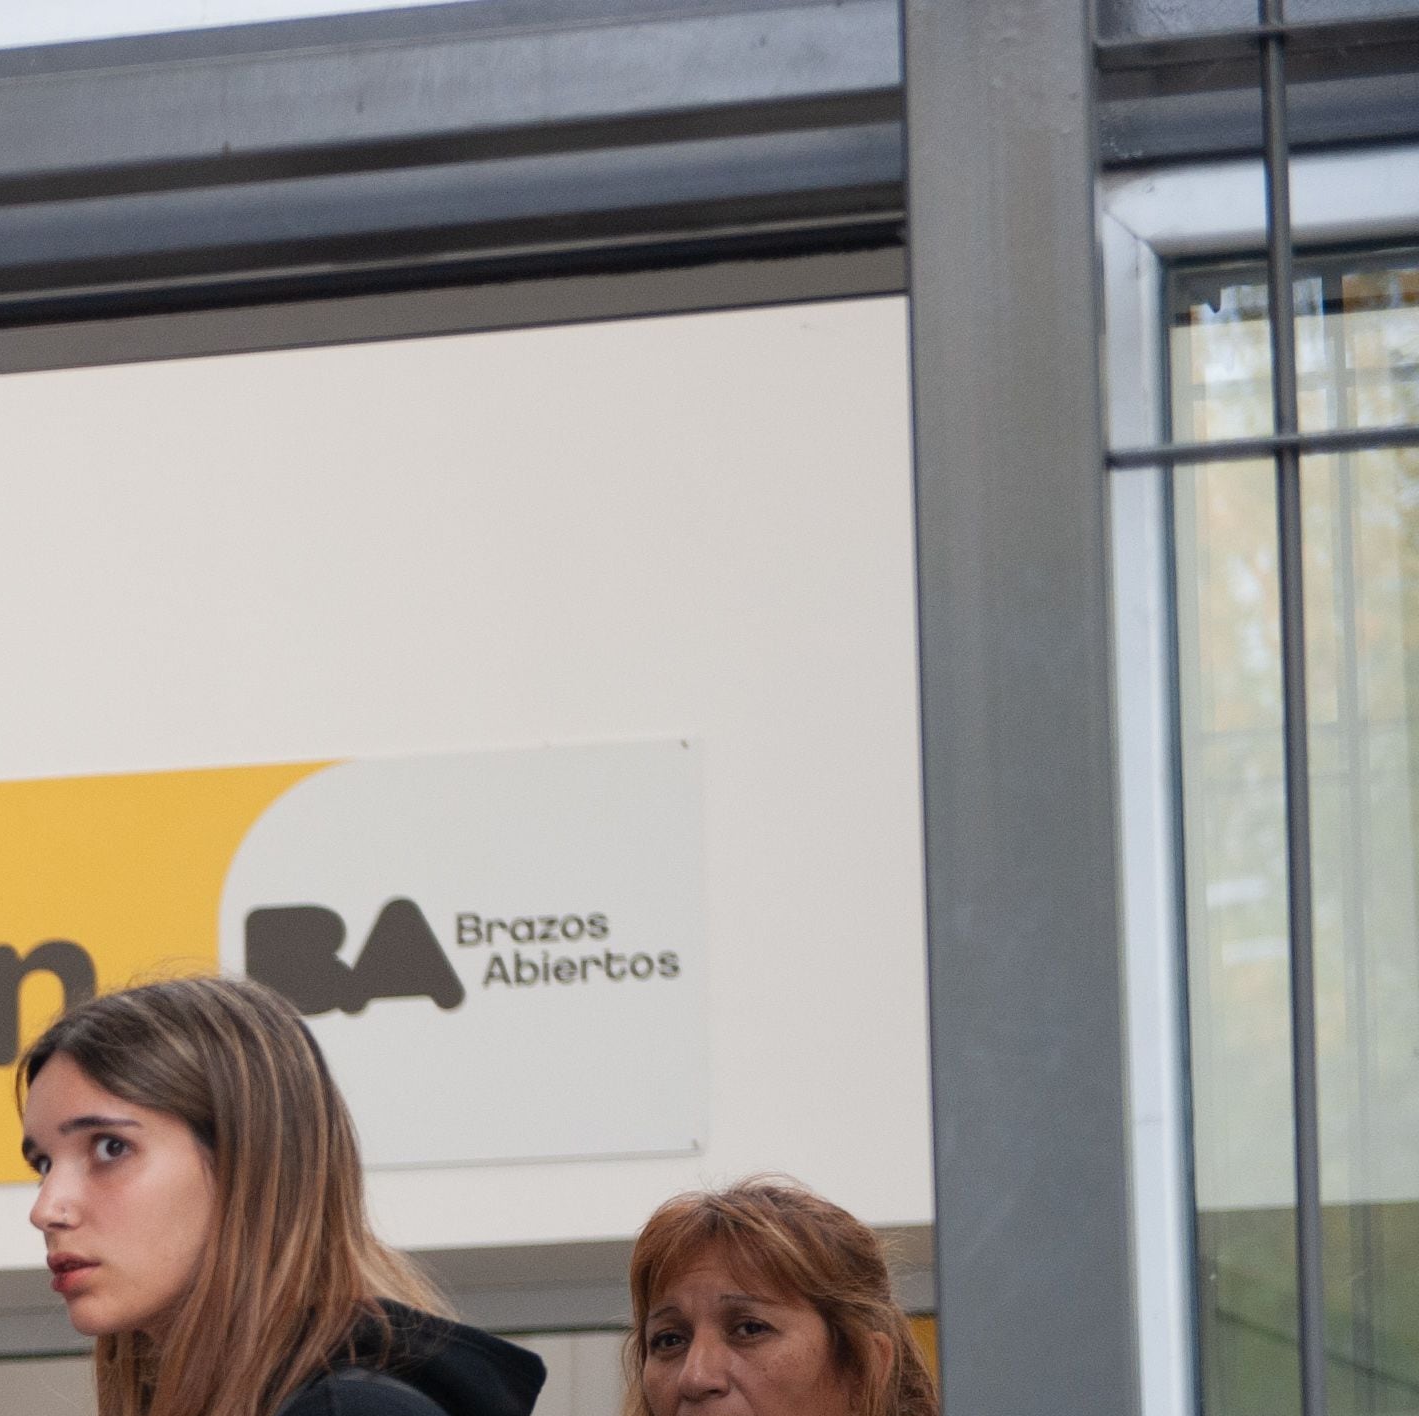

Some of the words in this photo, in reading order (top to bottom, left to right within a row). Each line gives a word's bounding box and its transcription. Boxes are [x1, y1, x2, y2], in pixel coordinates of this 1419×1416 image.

[455, 911, 610, 947] Brazos
[245, 897, 467, 1016] BA
[483, 949, 681, 990] Abiertos
